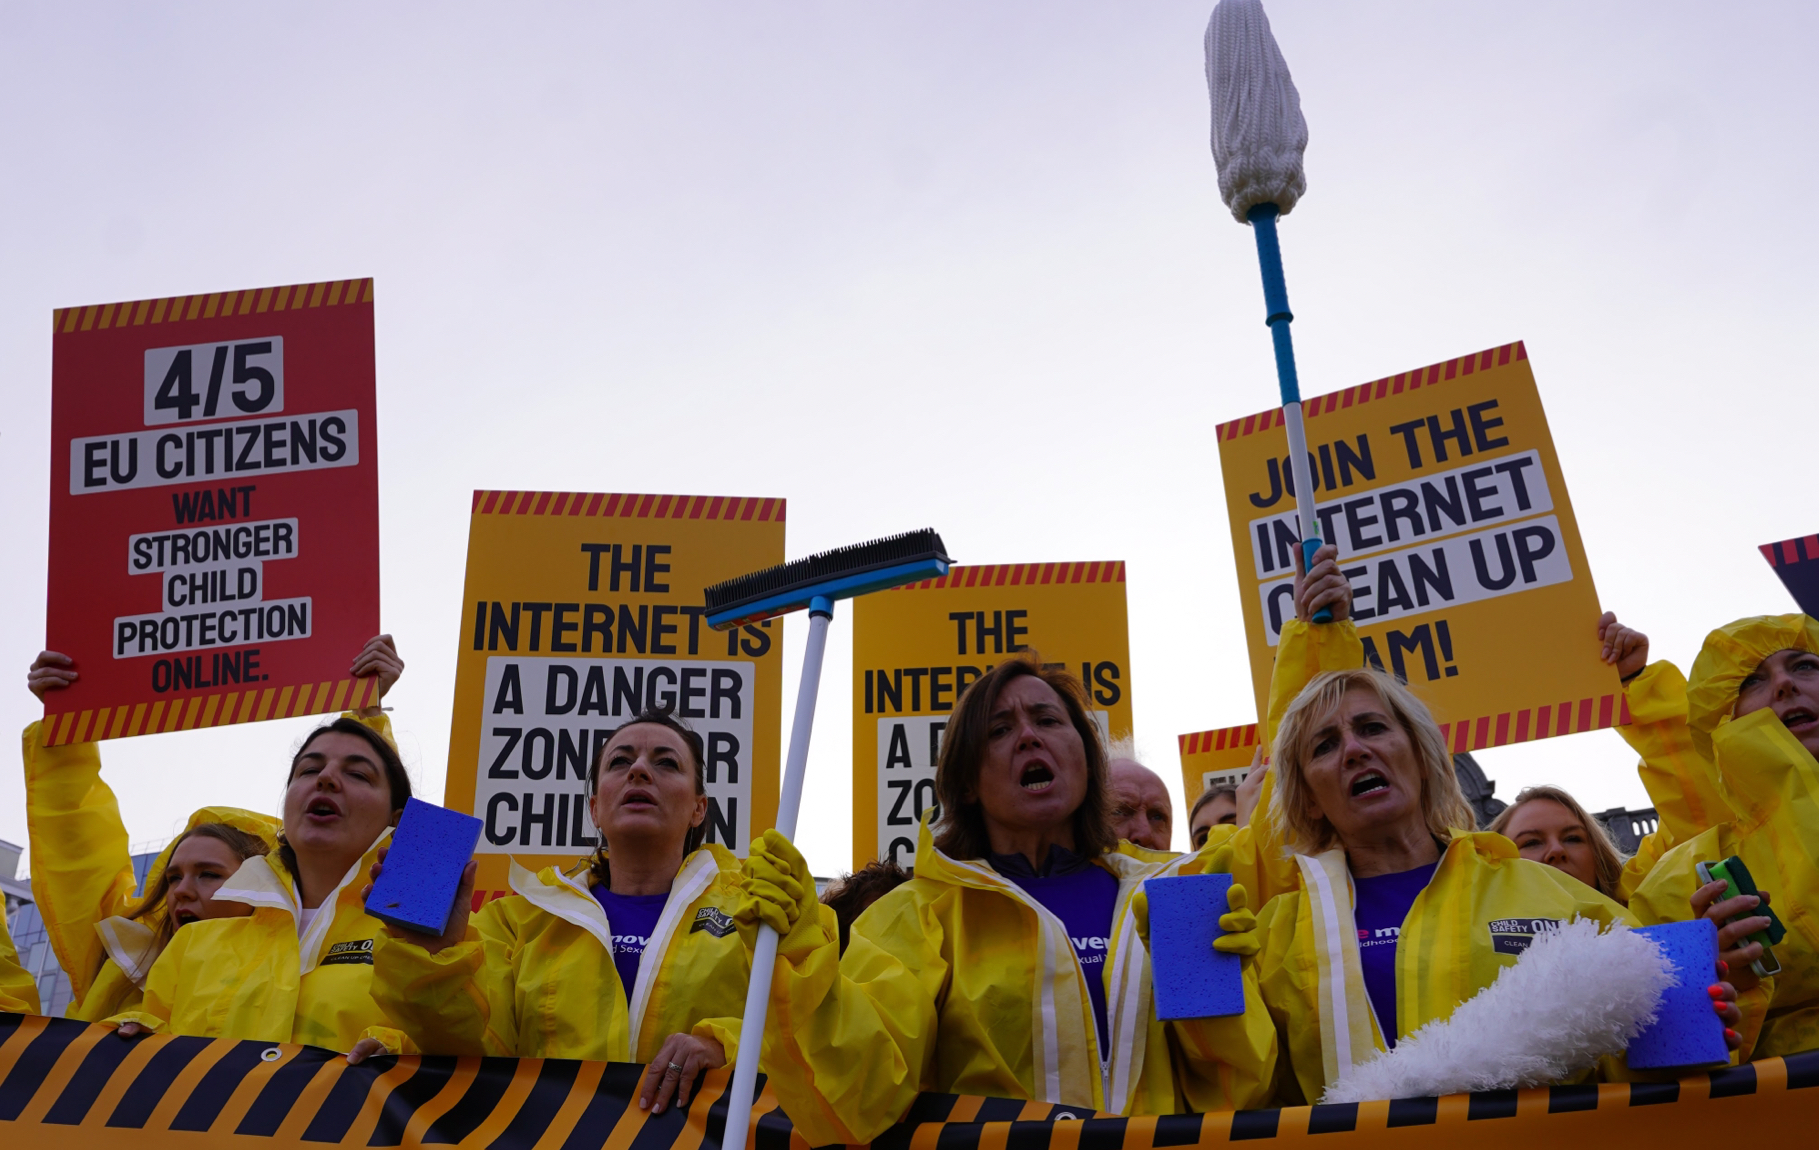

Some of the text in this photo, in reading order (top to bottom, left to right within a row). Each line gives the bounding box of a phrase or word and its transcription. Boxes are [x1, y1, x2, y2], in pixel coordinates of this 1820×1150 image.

[154, 341, 275, 420] 4/5
[83, 416, 347, 488] EU CITIZENS
[1390, 398, 1510, 470] THE
[172, 485, 256, 524] WANT
[1256, 456, 1533, 573] INTERNET
[132, 522, 293, 570] STRONGER
[581, 543, 672, 593] THE
[167, 566, 257, 607] CHILD
[1267, 525, 1556, 635] CEAN UP
[117, 602, 307, 655] PROTECTION
[473, 601, 706, 655] INTERNET
[949, 609, 1029, 655] THE
[151, 649, 269, 693] ONLINE.
[493, 664, 743, 720] A DANGER
[1082, 661, 1121, 707] IS
[886, 723, 912, 769] A
[484, 792, 737, 850] CHILN
[1490, 920, 1518, 928] CHILD
[1079, 954, 1102, 964] xual
